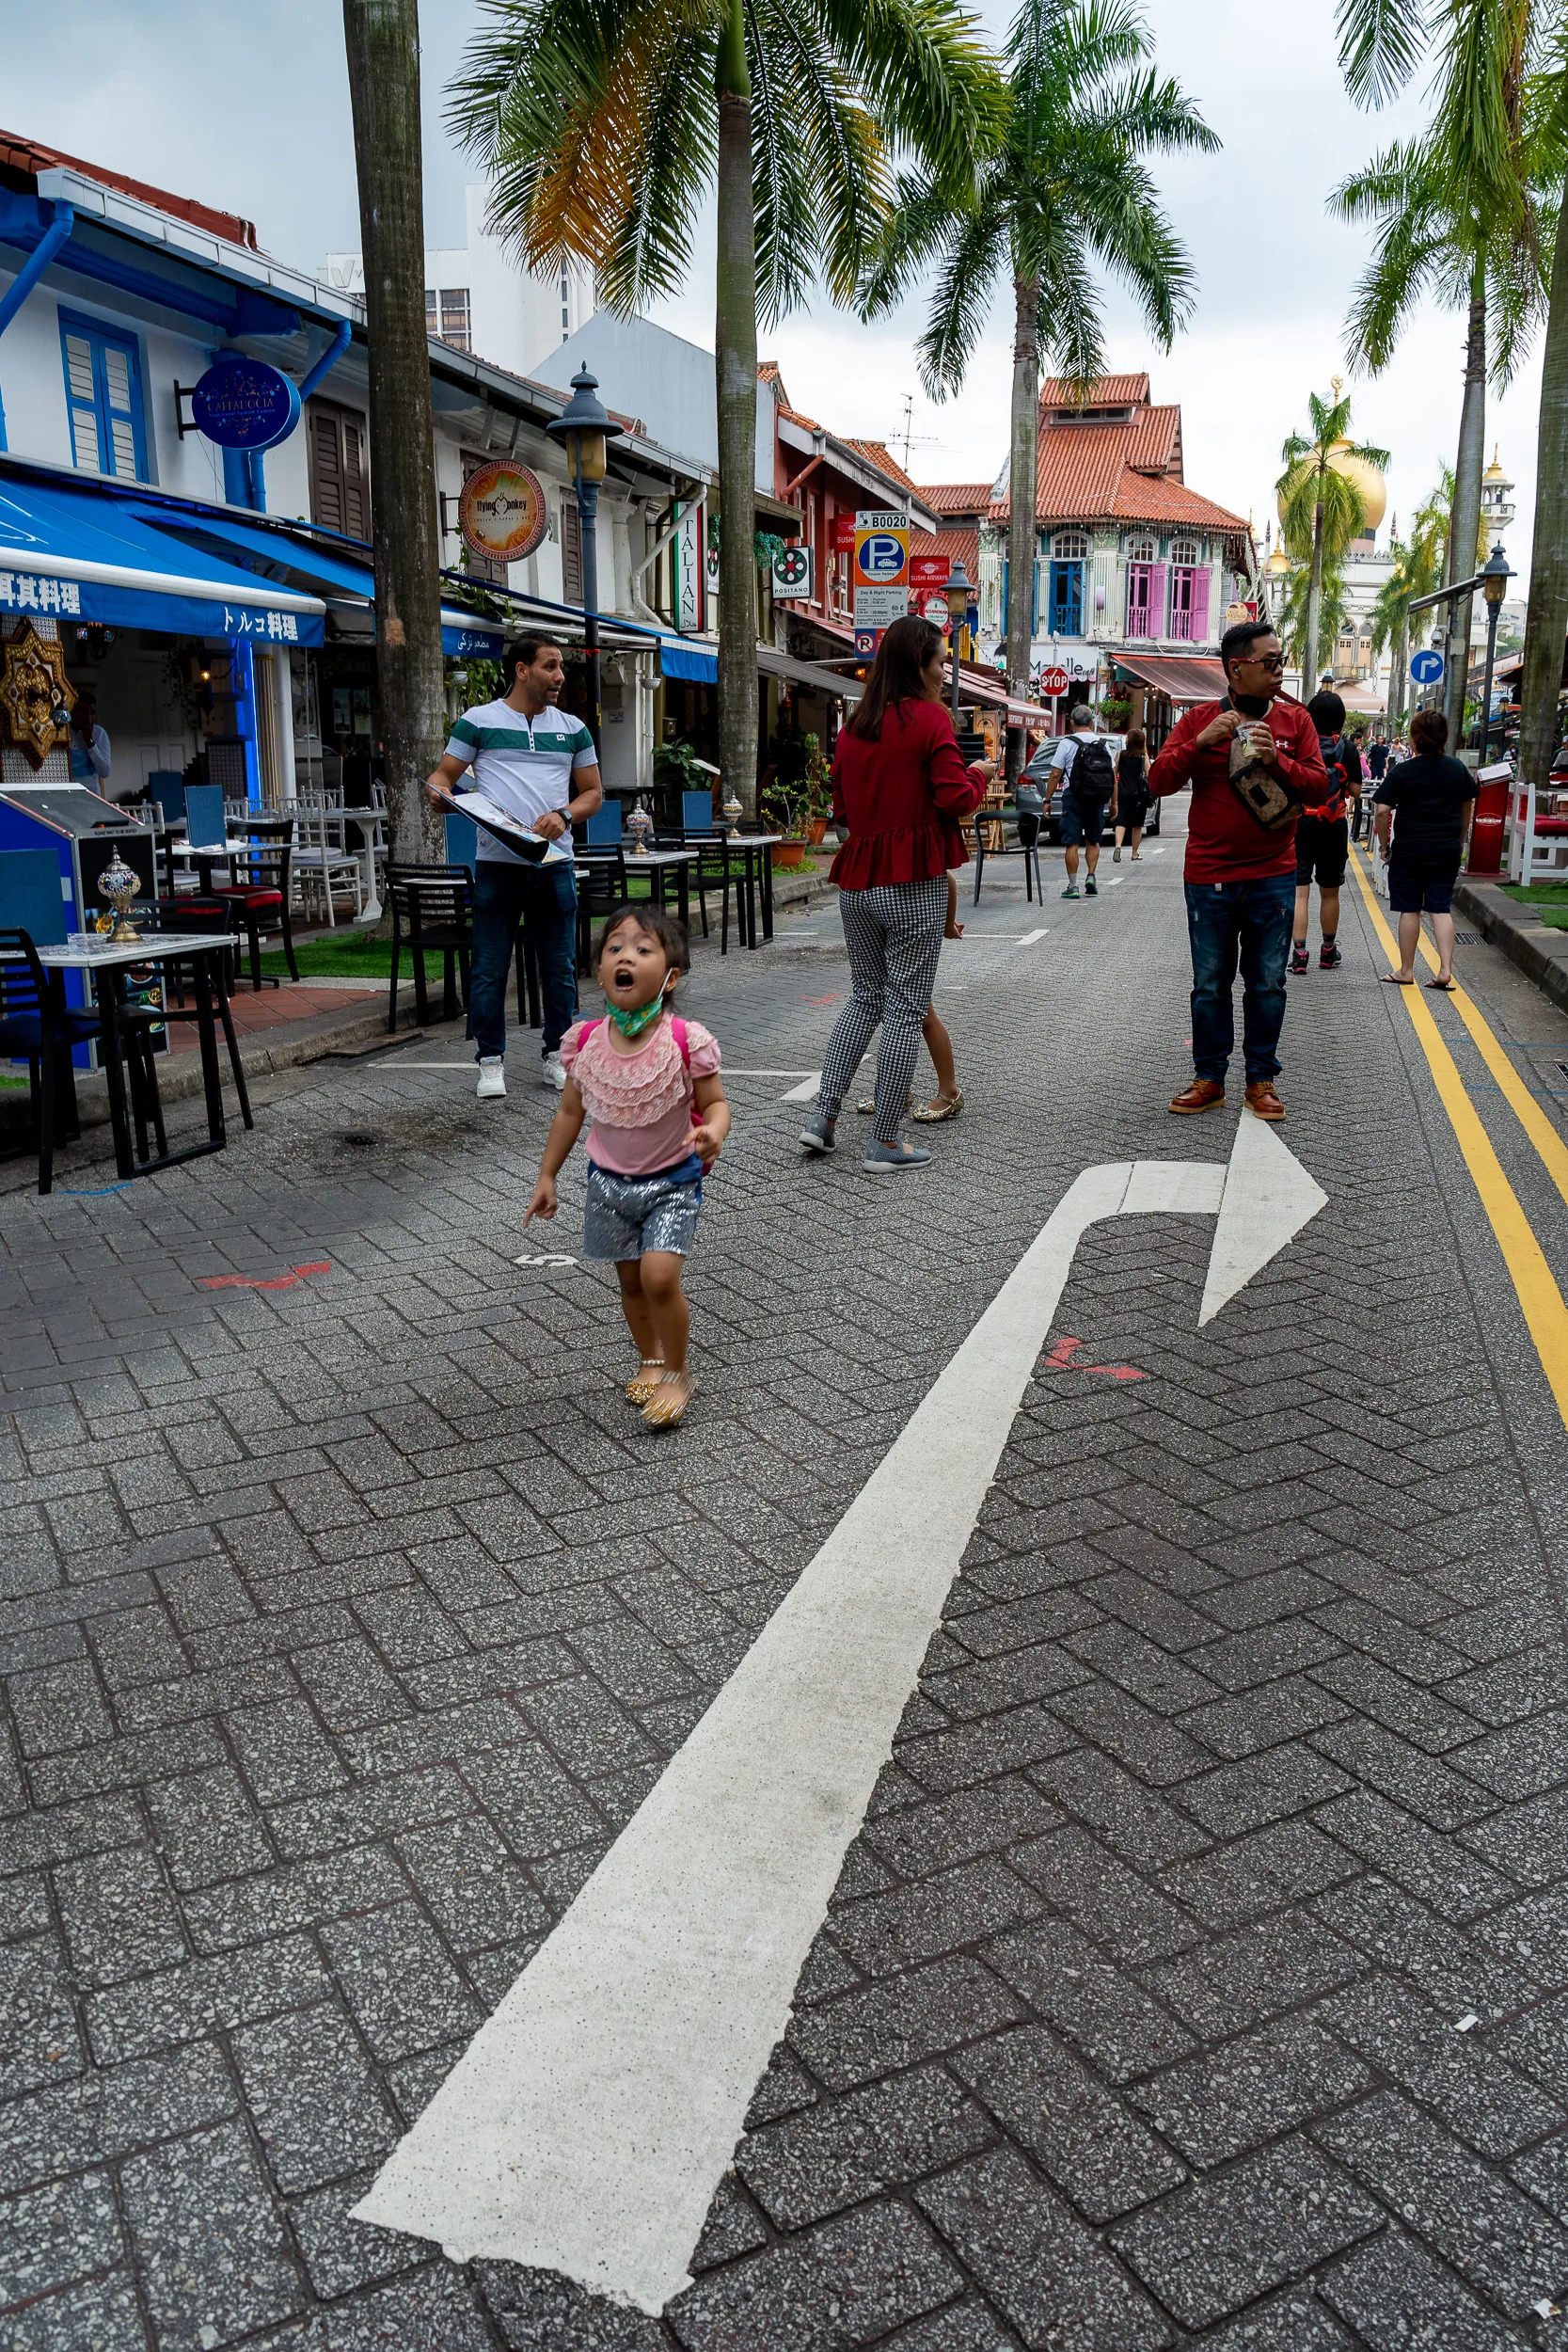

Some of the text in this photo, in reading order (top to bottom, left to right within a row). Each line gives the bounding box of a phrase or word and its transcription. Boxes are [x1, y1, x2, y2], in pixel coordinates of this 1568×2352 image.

[207, 398, 274, 412] CAPPADOCIA
[872, 516, 907, 528] B0020
[224, 606, 298, 641] トルコ料理
[1041, 675, 1068, 688] STOP
